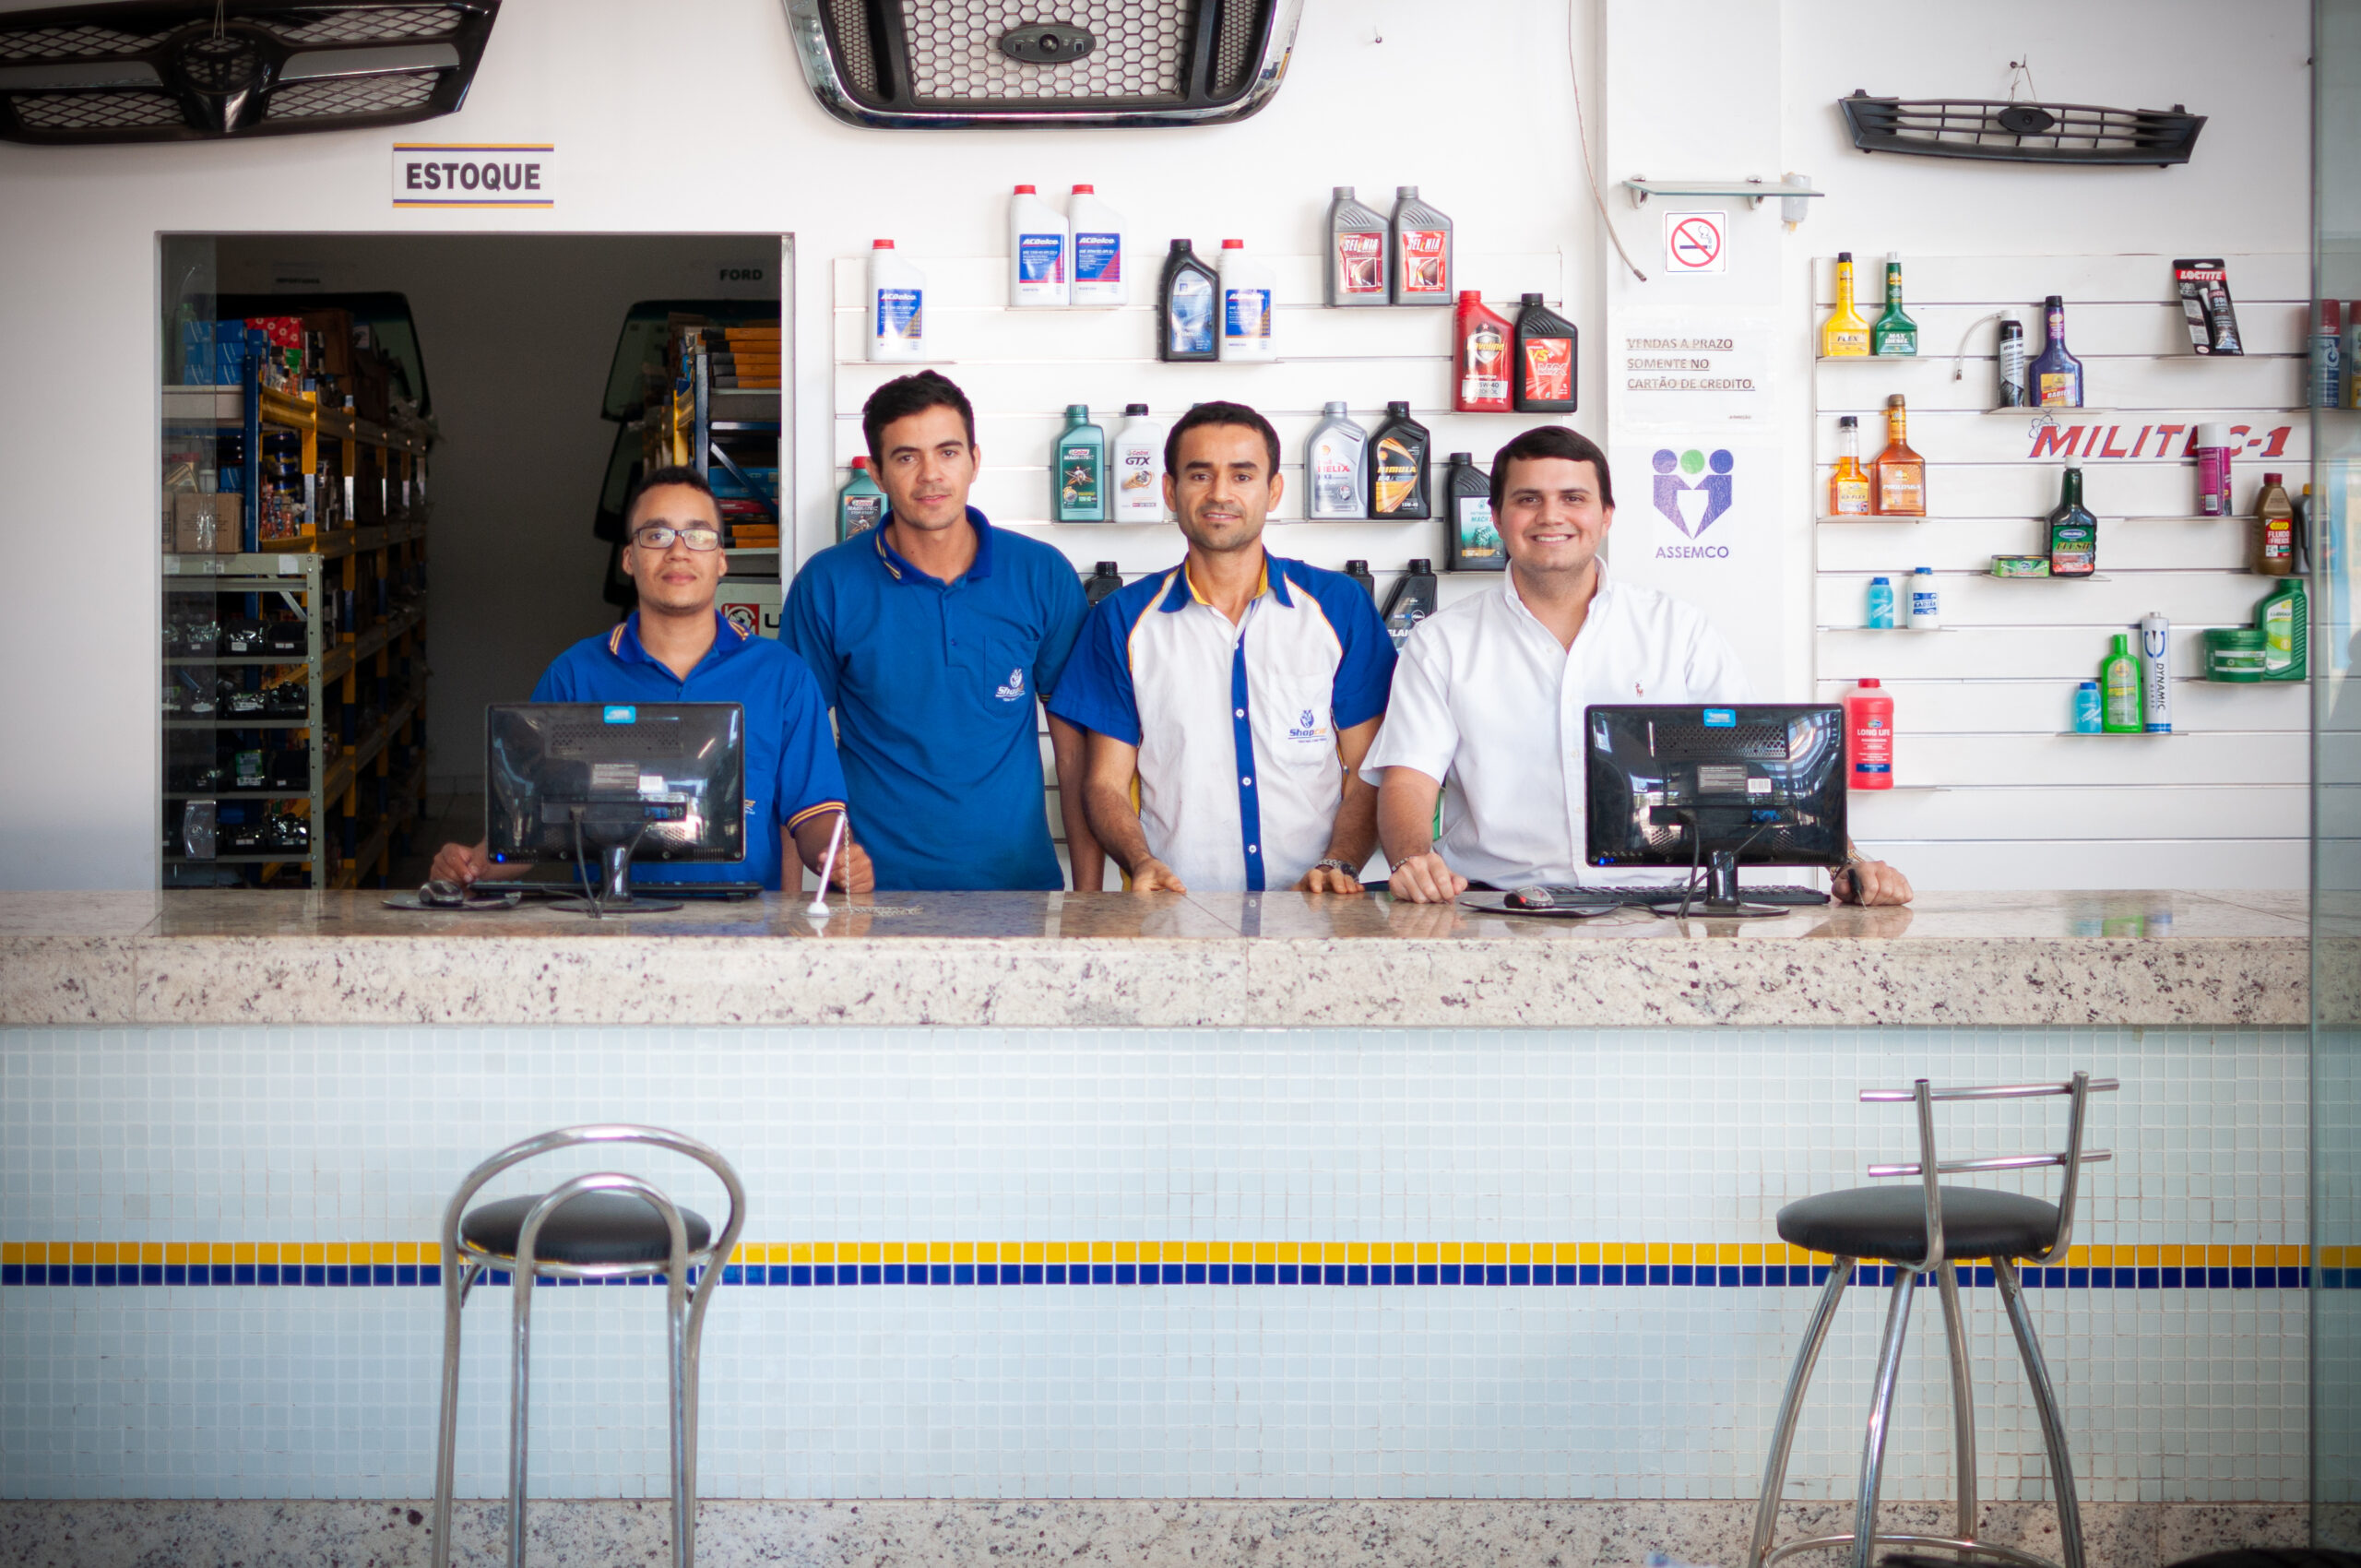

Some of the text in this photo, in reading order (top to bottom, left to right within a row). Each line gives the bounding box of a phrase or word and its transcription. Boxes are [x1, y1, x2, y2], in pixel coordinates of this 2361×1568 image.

[407, 162, 540, 191] ESTOQUE
[719, 268, 763, 281] FORD
[2180, 270, 2223, 280] LOCTITE
[1626, 339, 1734, 349] VENDAS A PRAZO
[1627, 359, 1710, 369] SOMENTE NO
[1627, 376, 1756, 389] CARTÃO DE CREDITO.
[1125, 457, 1150, 466] GTX
[1655, 545, 1729, 559] ASSEMCO
[2156, 663, 2166, 710] DYNAMIC
[1857, 729, 1891, 737] LONG LIFE
